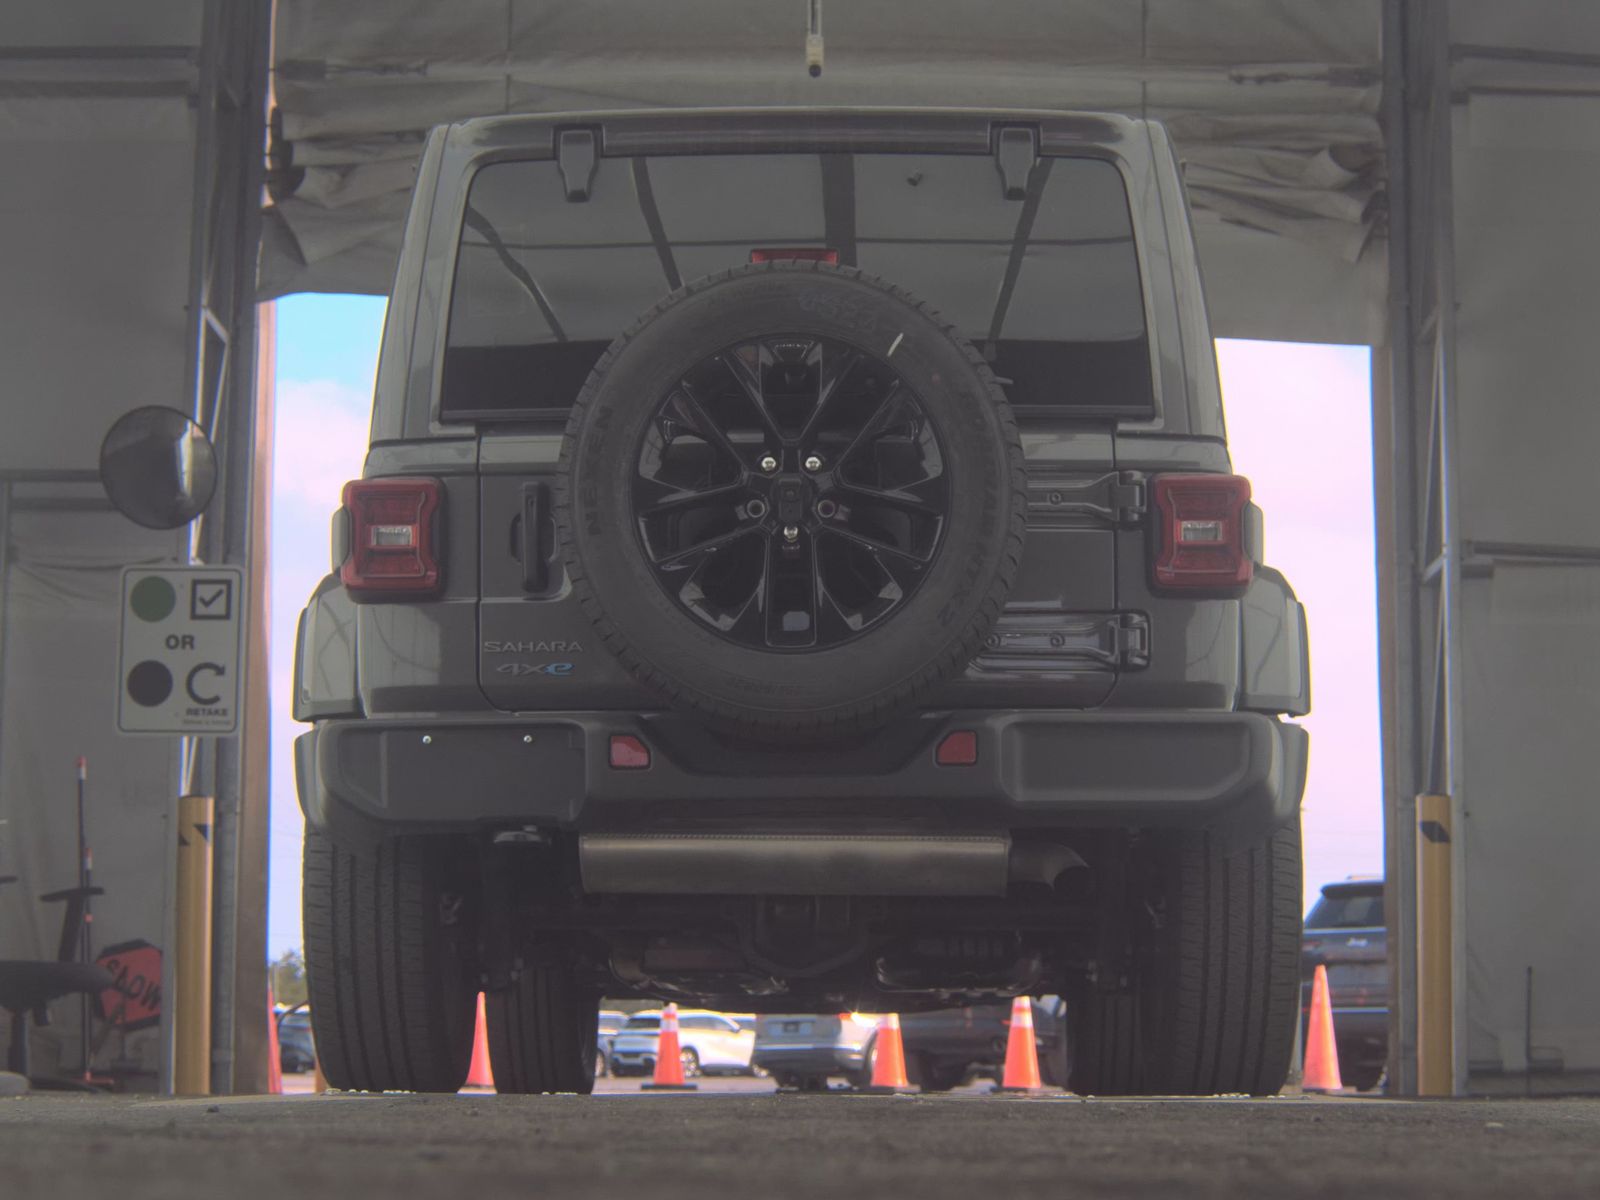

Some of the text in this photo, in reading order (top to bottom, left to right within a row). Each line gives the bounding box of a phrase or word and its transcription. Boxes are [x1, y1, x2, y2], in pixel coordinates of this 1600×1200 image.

[165, 634, 195, 650] OR
[484, 641, 584, 652] SAHARA
[186, 707, 228, 717] RETAKE
